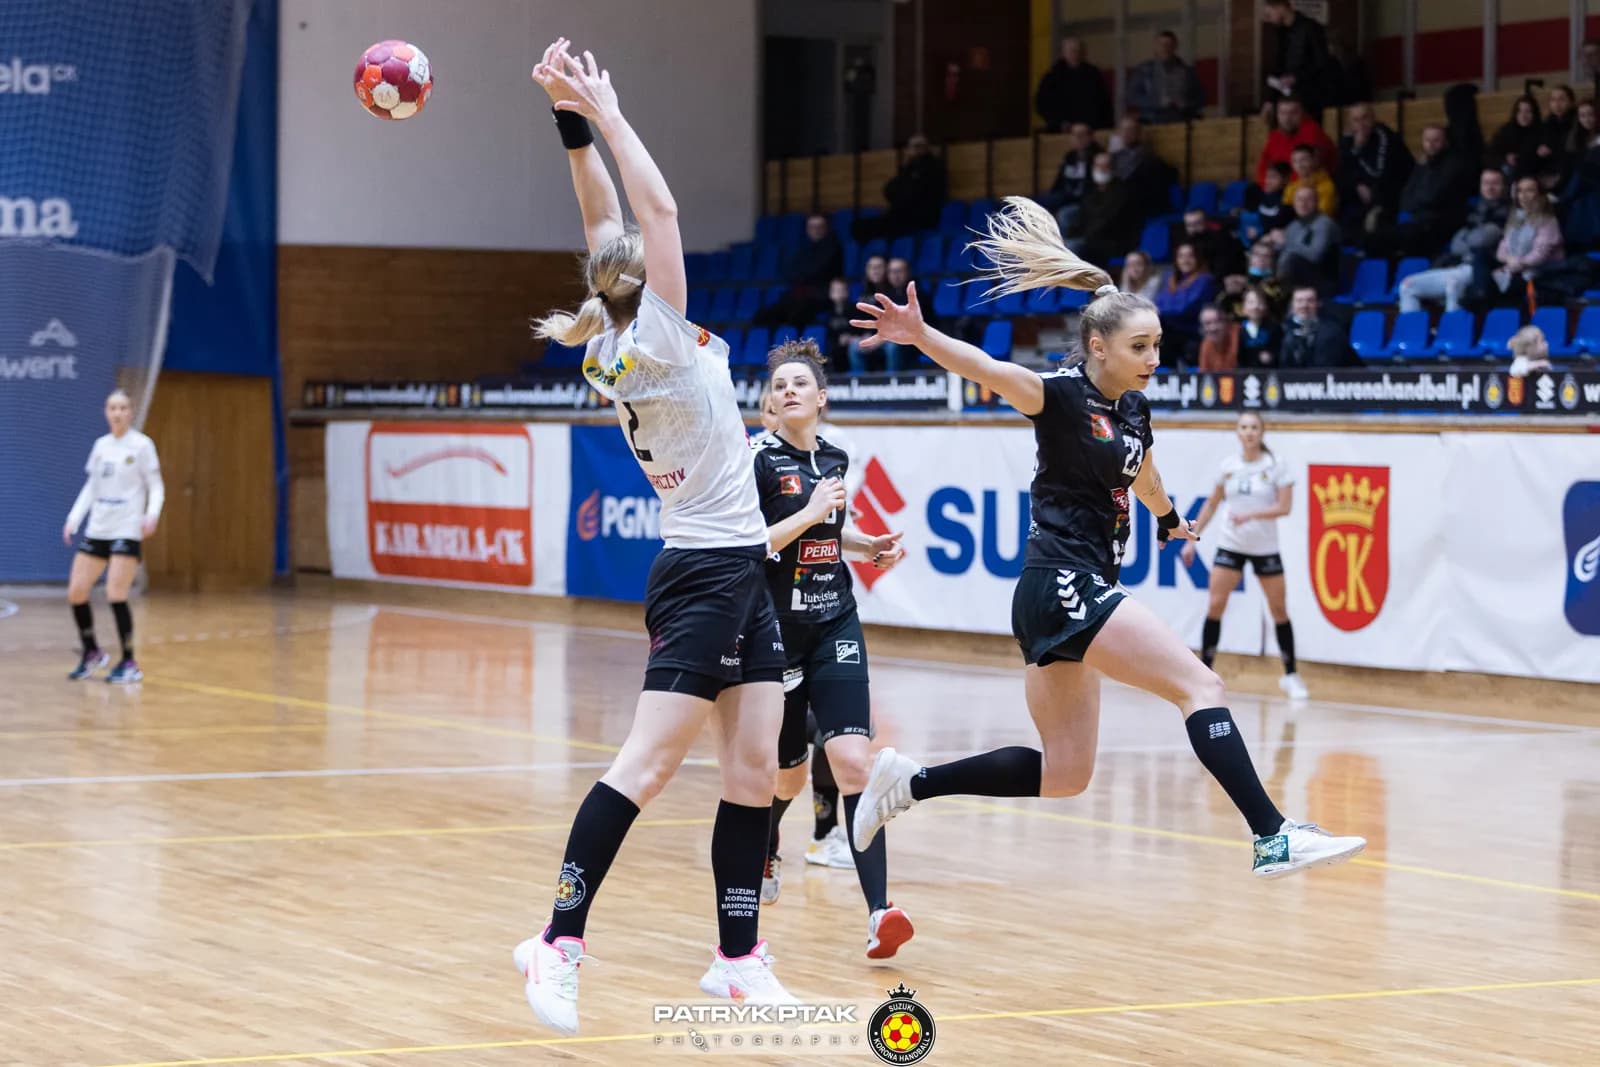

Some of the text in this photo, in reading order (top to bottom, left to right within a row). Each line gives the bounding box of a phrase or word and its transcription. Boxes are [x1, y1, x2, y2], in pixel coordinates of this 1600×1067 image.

[1283, 373, 1480, 409] www.koronahandball.pl
[1315, 529, 1375, 613] CK
[727, 887, 756, 896] SUZUKI
[725, 895, 758, 904] KORONA
[721, 903, 759, 911] HANDBALL
